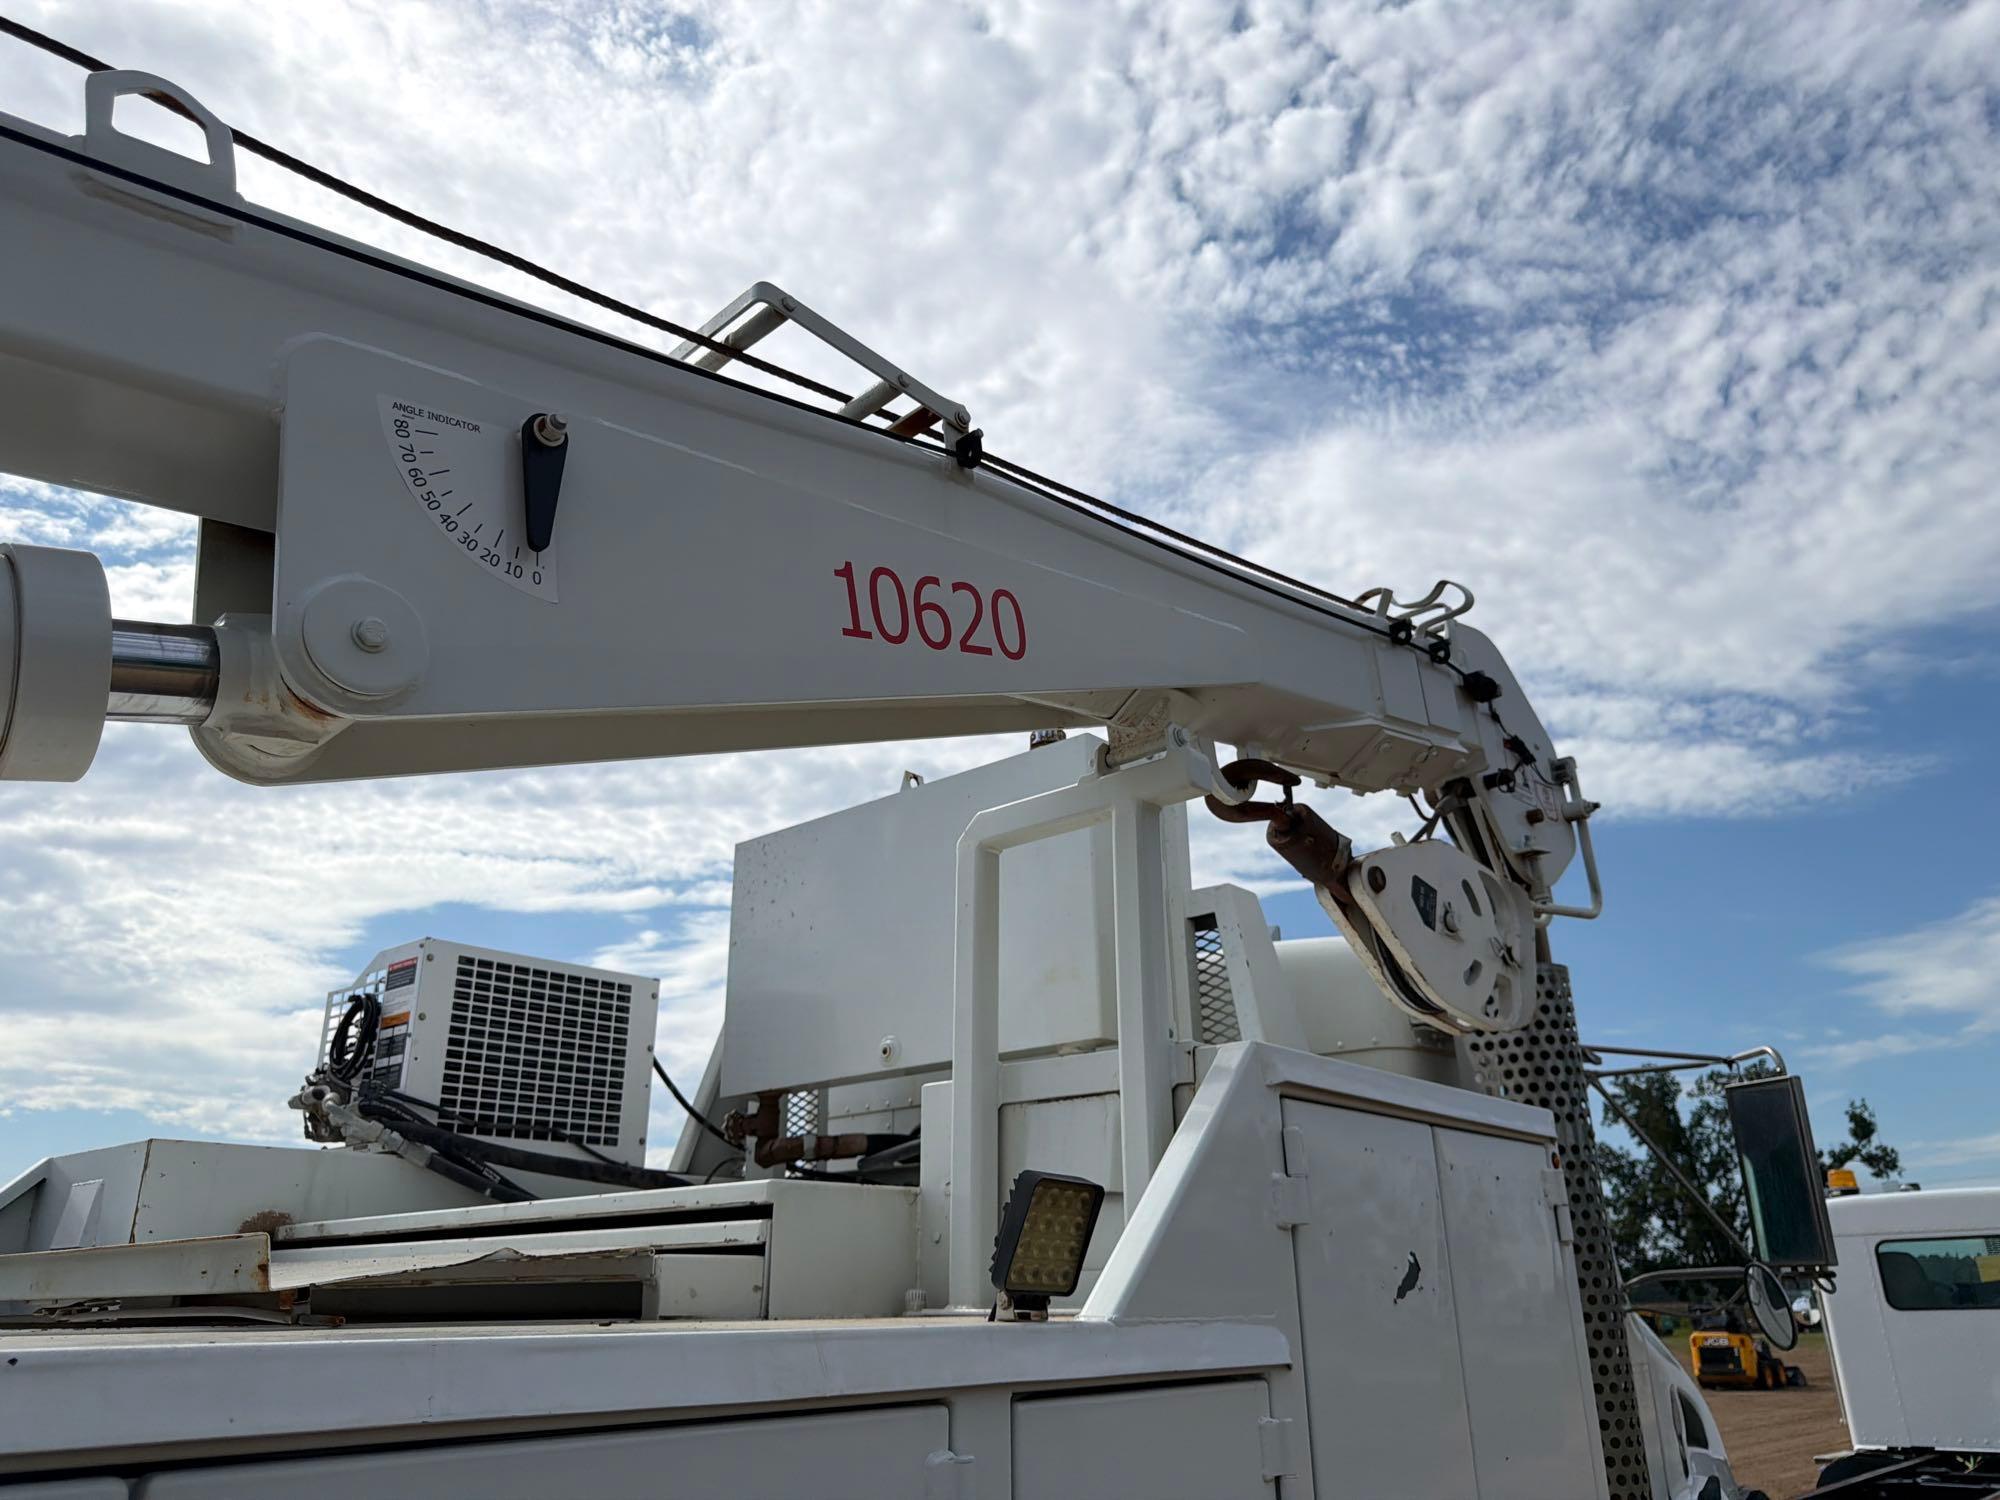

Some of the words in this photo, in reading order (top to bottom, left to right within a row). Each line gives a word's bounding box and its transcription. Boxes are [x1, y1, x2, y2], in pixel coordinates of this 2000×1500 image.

[392, 401, 425, 417] ANGLE
[427, 411, 481, 433] INDICATOR
[394, 418, 410, 438] 80
[398, 443, 416, 463] 70
[408, 468, 427, 487] 60
[421, 490, 441, 511] 50
[439, 514, 458, 532] 40
[457, 531, 478, 551] 30
[479, 548, 500, 567] 20
[504, 561, 523, 579] 10
[532, 571, 542, 585] 0
[834, 561, 1026, 661] 10620
